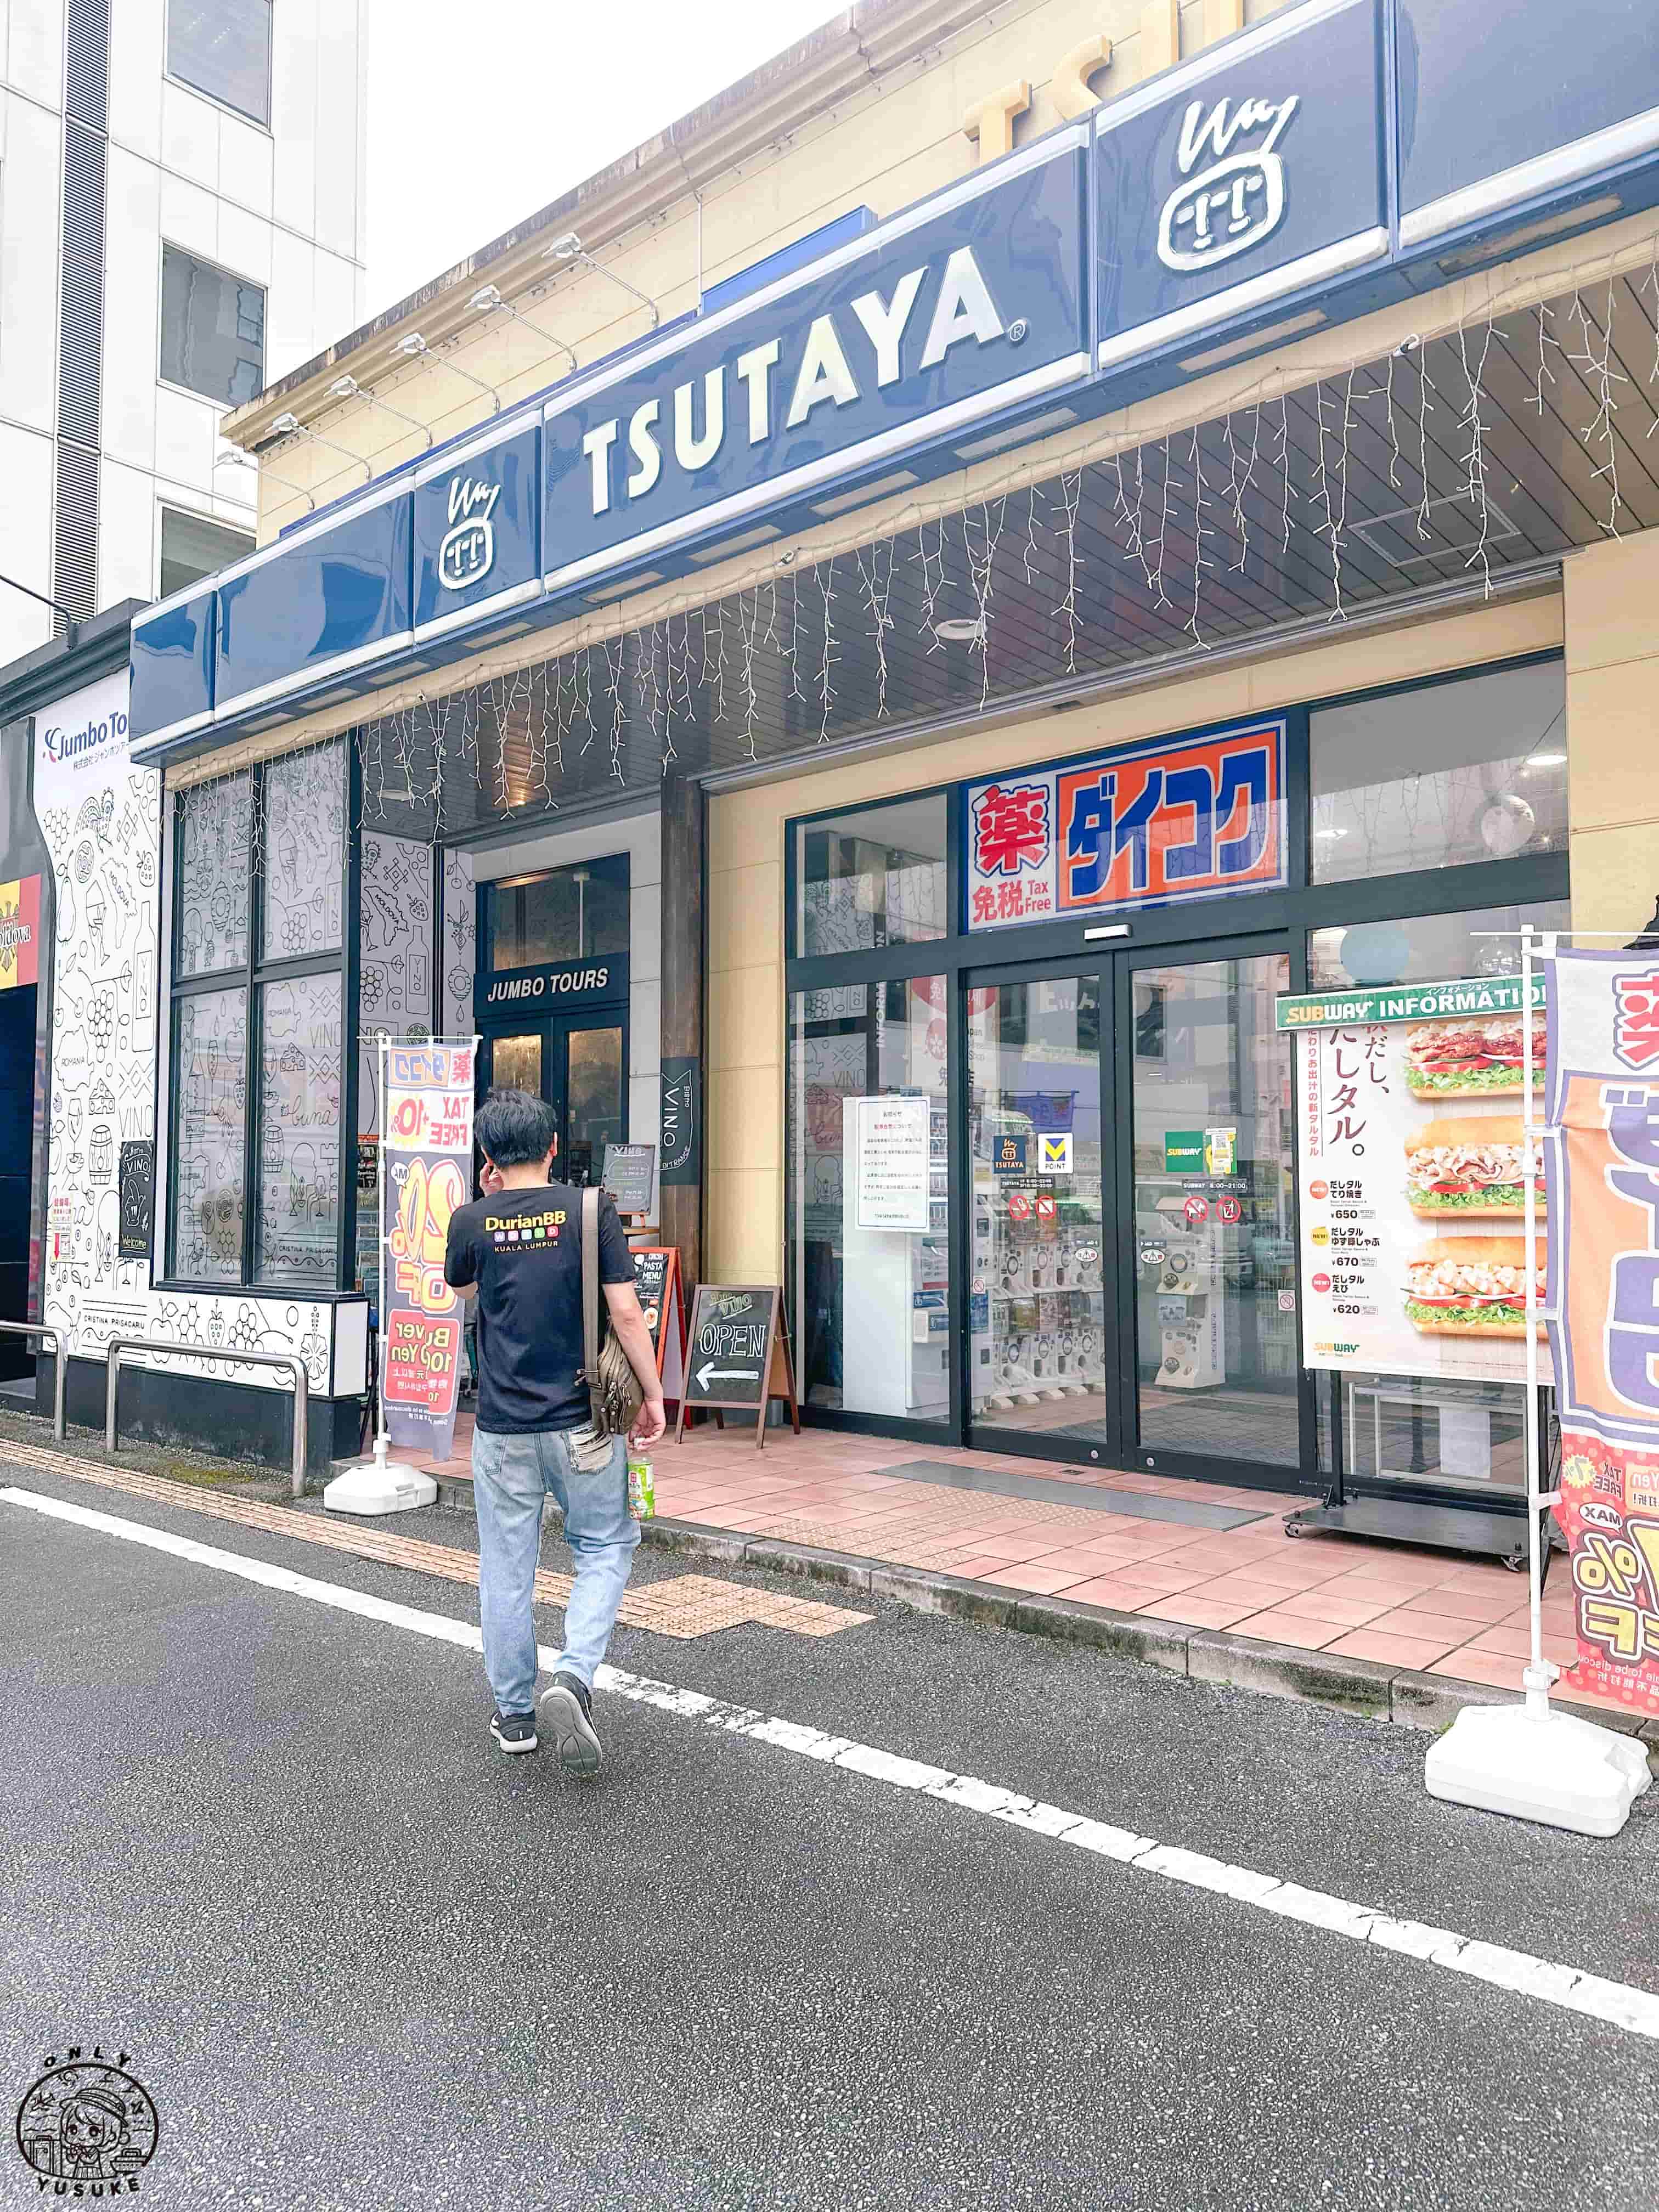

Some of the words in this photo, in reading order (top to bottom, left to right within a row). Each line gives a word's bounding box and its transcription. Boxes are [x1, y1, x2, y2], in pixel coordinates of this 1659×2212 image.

[583, 245, 1005, 517] TSUTAYA
[58, 721, 108, 760] Jumbo
[1065, 746, 1269, 900] ダイコク
[973, 785, 1049, 877] 薬
[109, 871, 130, 906] MOLDOVA
[1028, 879, 1048, 895] Tax
[374, 894, 399, 925] MOLDOVA
[972, 880, 1024, 924] 免税
[1025, 895, 1051, 912] Free
[487, 976, 545, 1002] JUMBO
[550, 967, 608, 994] TOURS
[1426, 983, 1490, 995] インフォメーション
[1285, 1000, 1374, 1024] SUBWAY
[61, 1057, 85, 1067] ROMANIA
[118, 1104, 153, 1138] VINO
[663, 1087, 680, 1147] VINO
[1167, 1148, 1203, 1156] SUBWAY
[126, 1159, 149, 1173] VINO
[1330, 1180, 1362, 1189] だしタル
[1330, 1190, 1362, 1199] てり焼き
[485, 1210, 567, 1232] DurianBB
[1331, 1210, 1358, 1219] ¥650
[1331, 1227, 1363, 1236] だしタル
[122, 1235, 147, 1249] Welcome
[494, 1245, 522, 1253] KUALA
[526, 1241, 558, 1250] LUMPUR
[644, 1262, 663, 1271] PASTA
[1331, 1257, 1359, 1266] ¥670
[642, 1272, 662, 1280] MENU
[1332, 1274, 1364, 1284] だしタル
[1332, 1284, 1348, 1293] えび
[719, 1294, 752, 1316] VINO
[1333, 1305, 1361, 1314] ¥620
[84, 1314, 108, 1324] CRISTINA
[111, 1318, 145, 1330] PRISACARIU
[698, 1323, 766, 1357] OPEN
[1313, 1342, 1361, 1353] SUBWAY
